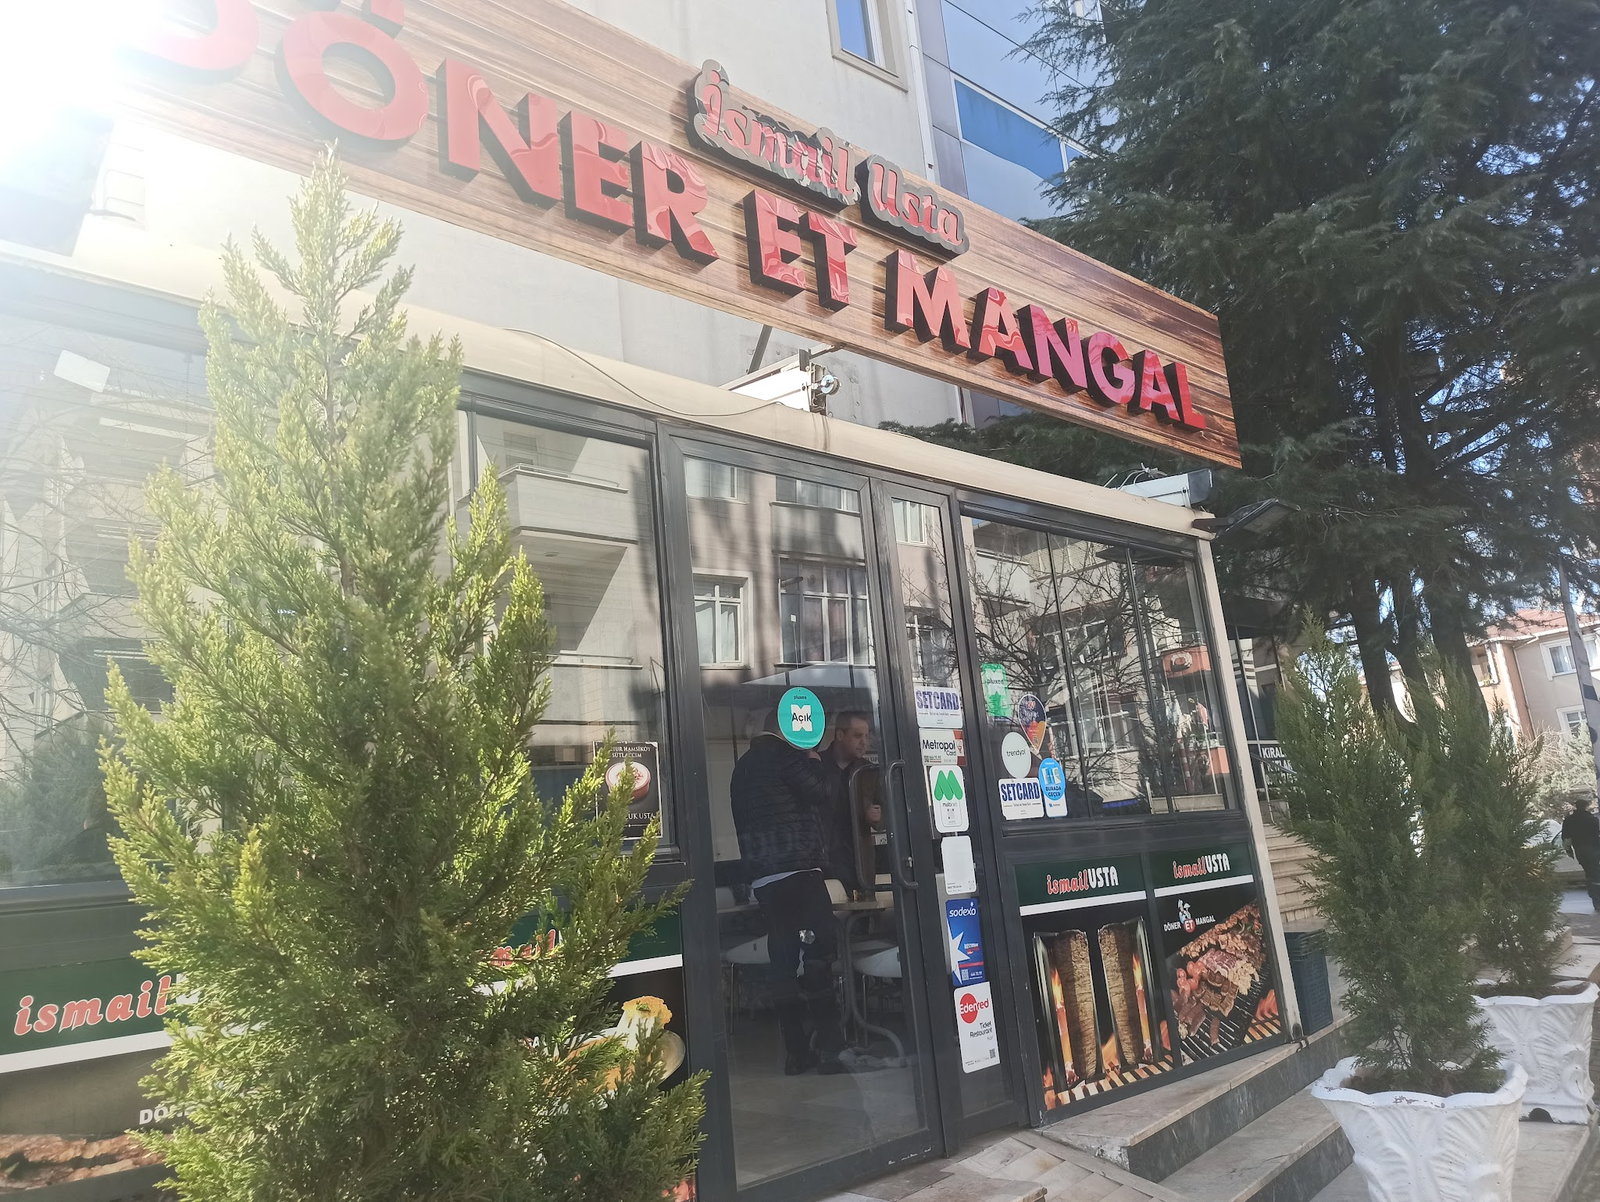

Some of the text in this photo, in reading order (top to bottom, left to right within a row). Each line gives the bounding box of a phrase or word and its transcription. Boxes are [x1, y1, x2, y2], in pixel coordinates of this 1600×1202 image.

[870, 161, 964, 246] Usta
[755, 190, 858, 306] ET
[896, 250, 1207, 431] MANGAL
[915, 690, 959, 711] SETCARD
[791, 712, 812, 724] Açık
[922, 739, 956, 751] Metropol
[1006, 749, 1025, 757] trendyol
[1001, 782, 1041, 802] SETCARD
[949, 906, 976, 917] sodexo
[1163, 915, 1216, 931] DÖNER ET MANGAL
[959, 998, 989, 1015] Edenred
[979, 1020, 992, 1029] Ticket
[969, 1027, 993, 1038] Restaurant
